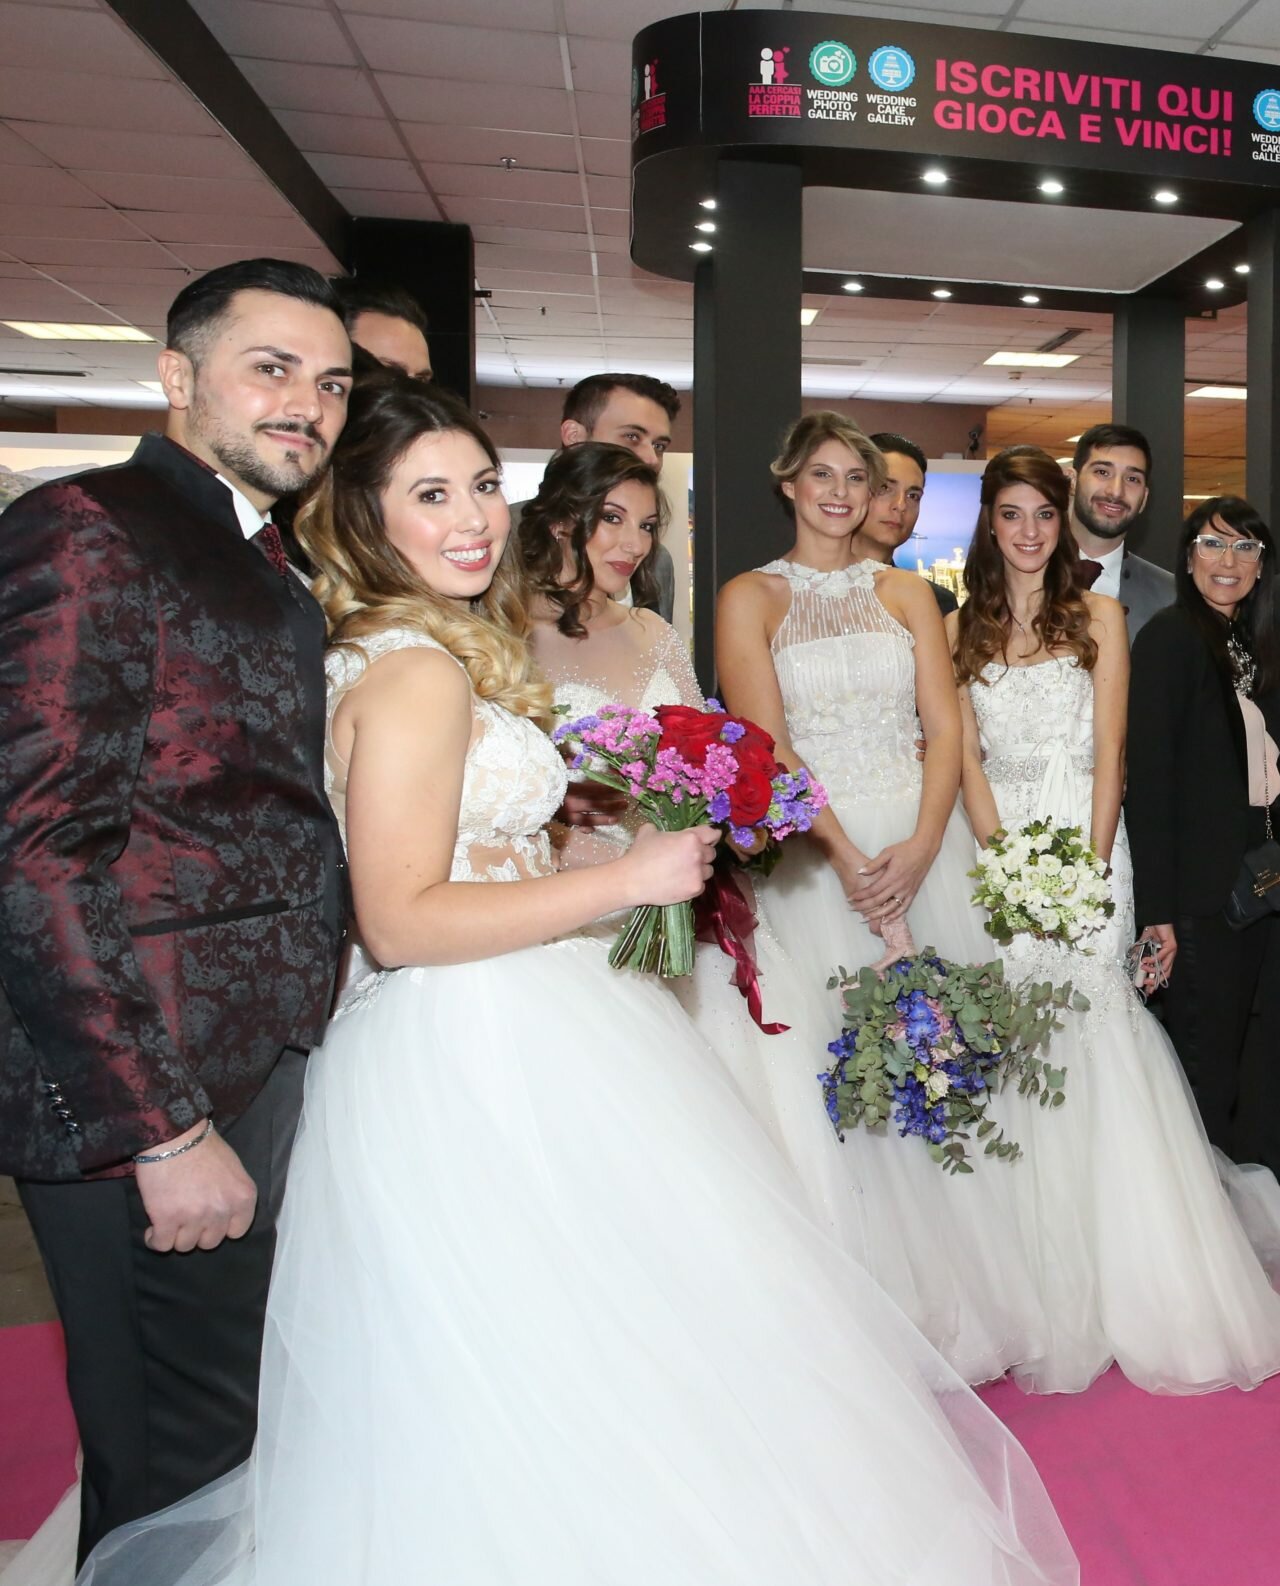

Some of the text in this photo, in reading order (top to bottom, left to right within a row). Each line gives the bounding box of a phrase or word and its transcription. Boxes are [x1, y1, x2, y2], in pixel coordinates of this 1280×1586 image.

[767, 86, 801, 95] CERCASI
[806, 89, 858, 102] WEDDING
[936, 59, 1233, 122] ISCRIVITI QUI
[749, 95, 801, 105] LA COPPIA
[813, 100, 852, 112] PHOTO
[866, 93, 917, 107] WEDDING
[749, 105, 801, 115] PERFETTA
[808, 108, 857, 122] GALLERY
[877, 104, 906, 116] CAKE
[867, 113, 916, 127] GALLERY
[933, 100, 1232, 157] GIOCA E VINCI!
